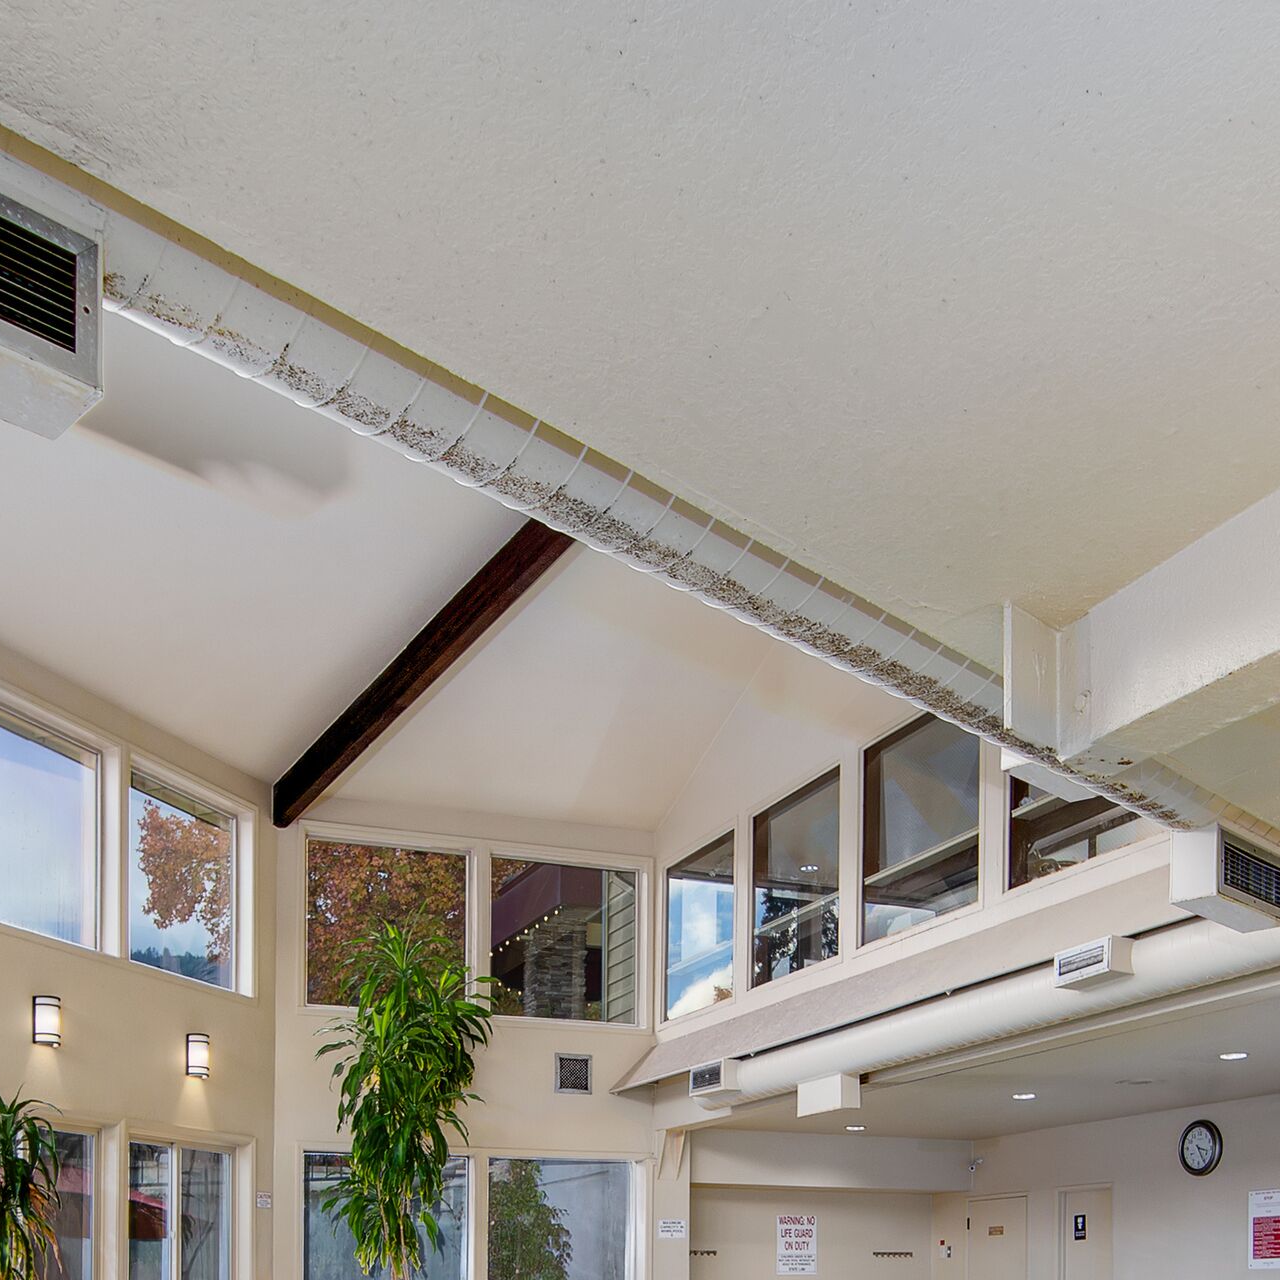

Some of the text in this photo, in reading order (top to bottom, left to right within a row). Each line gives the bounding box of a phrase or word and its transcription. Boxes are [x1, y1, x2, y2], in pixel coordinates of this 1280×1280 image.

[807, 1216, 816, 1225] NO
[781, 1228, 813, 1238] LIFE GUARD
[784, 1241, 809, 1250] ON DUTY
